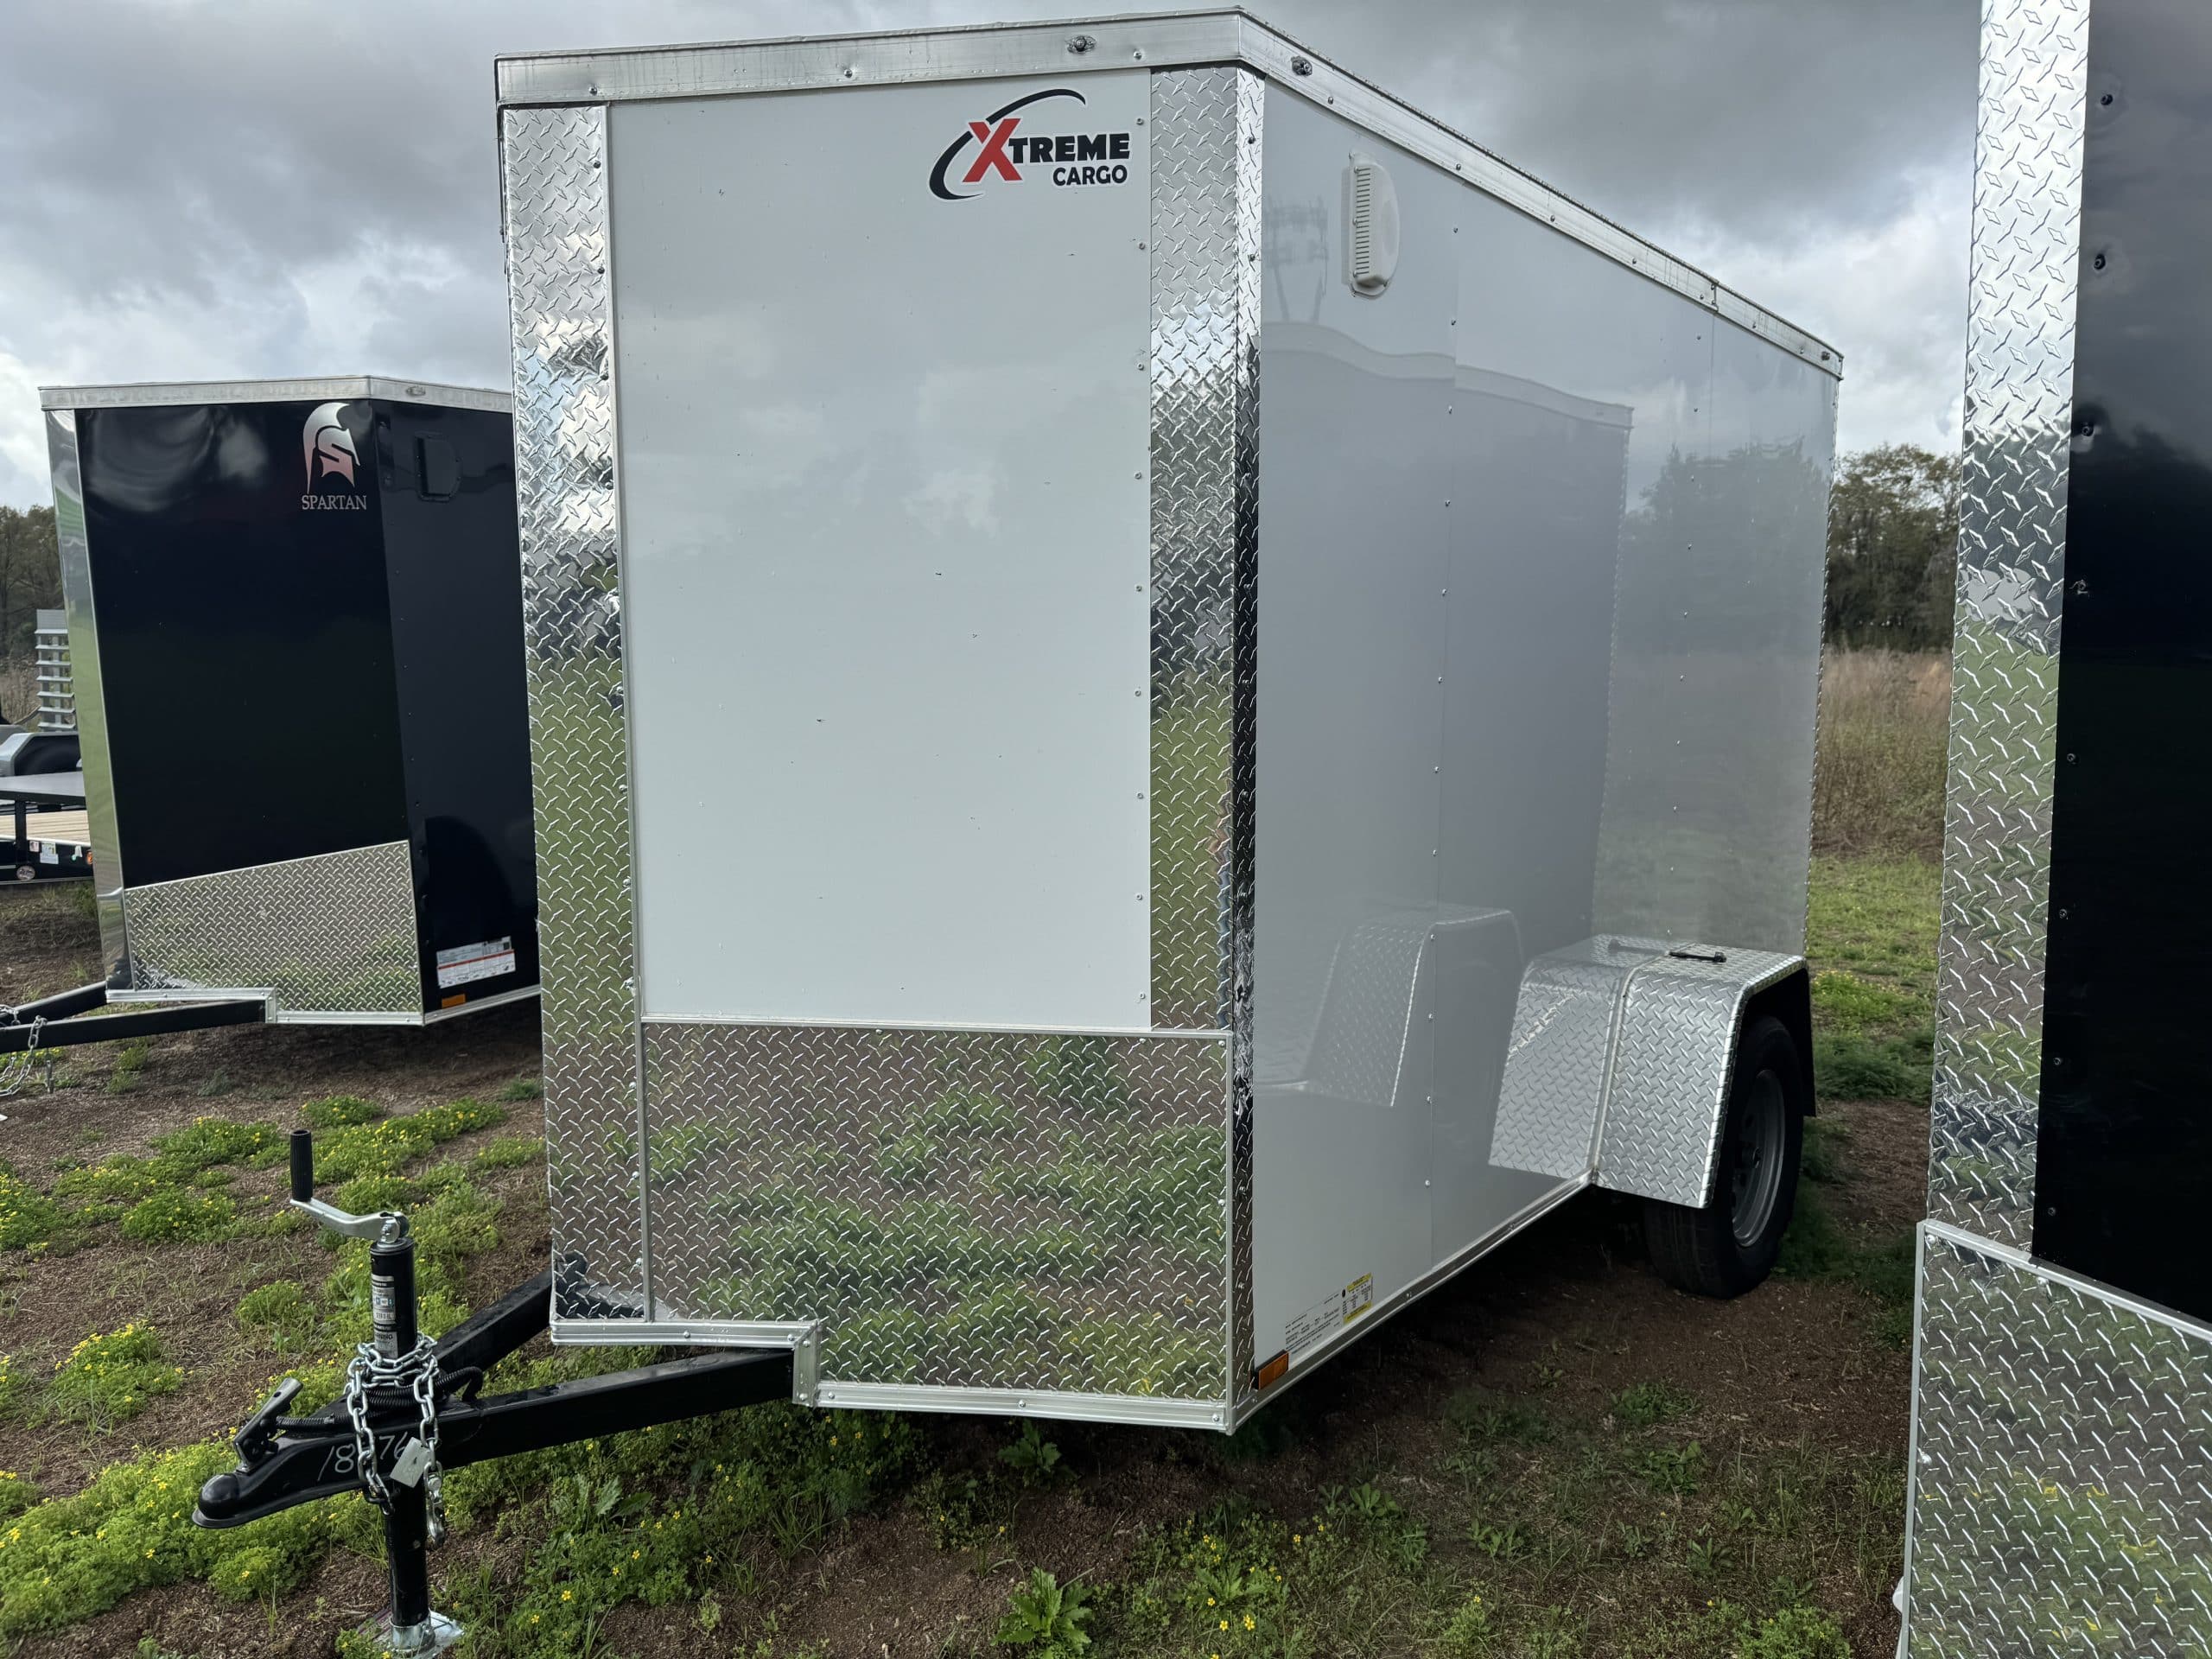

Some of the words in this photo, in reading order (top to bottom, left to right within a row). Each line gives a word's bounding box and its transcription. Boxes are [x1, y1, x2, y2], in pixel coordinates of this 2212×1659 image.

[962, 118, 1130, 183] XTREME
[1052, 164, 1128, 187] CARGO
[301, 494, 367, 511] SPARTAN
